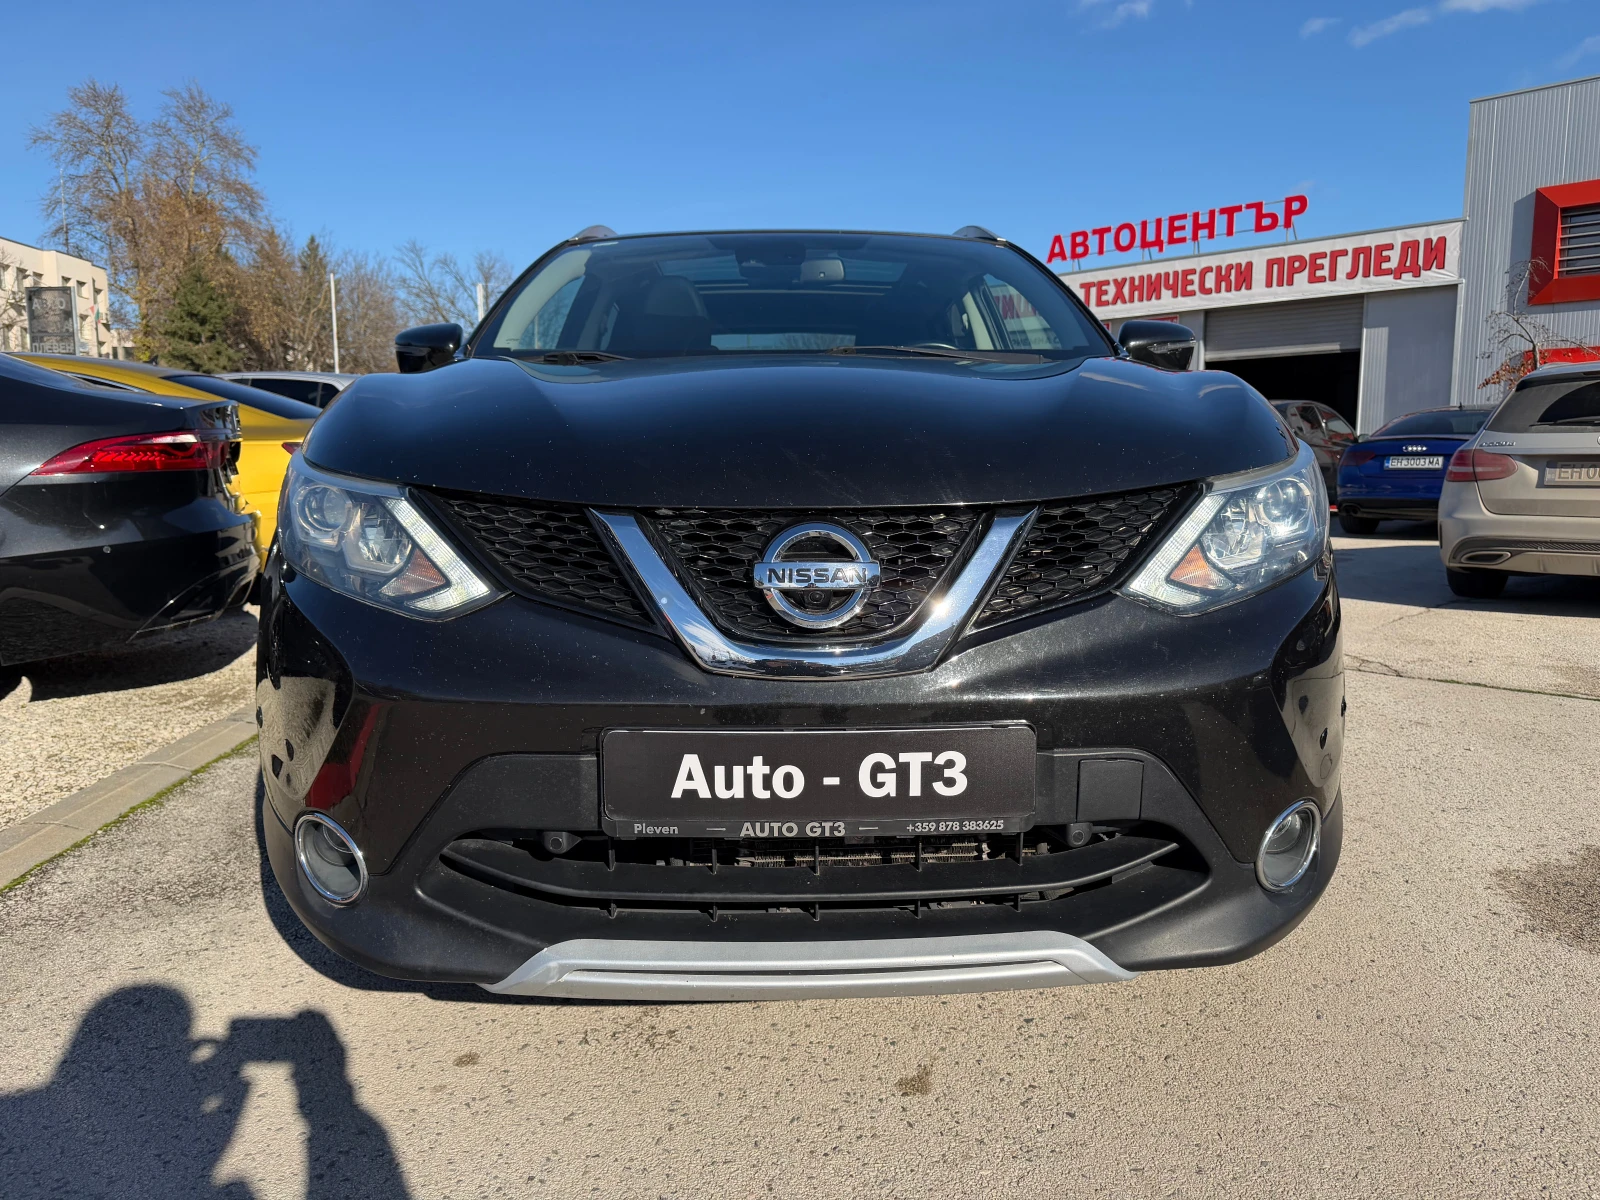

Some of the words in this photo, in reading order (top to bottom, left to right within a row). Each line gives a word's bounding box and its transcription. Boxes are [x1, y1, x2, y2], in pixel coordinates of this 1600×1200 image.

[1046, 194, 1309, 264] АВТОЦЕНТЪР
[1079, 261, 1253, 307] ТЕХНИЧЕСКИ
[1265, 236, 1447, 288] ПРЕГЛЕДИ
[767, 567, 867, 583] NISSAN
[670, 753, 805, 799] Auto
[858, 751, 968, 797] GT3
[633, 823, 679, 834] Pleven
[739, 822, 798, 837] AUTO
[805, 821, 846, 837] GT3
[906, 823, 939, 832] +359
[939, 821, 960, 831] 878
[962, 820, 1004, 831] 383625
